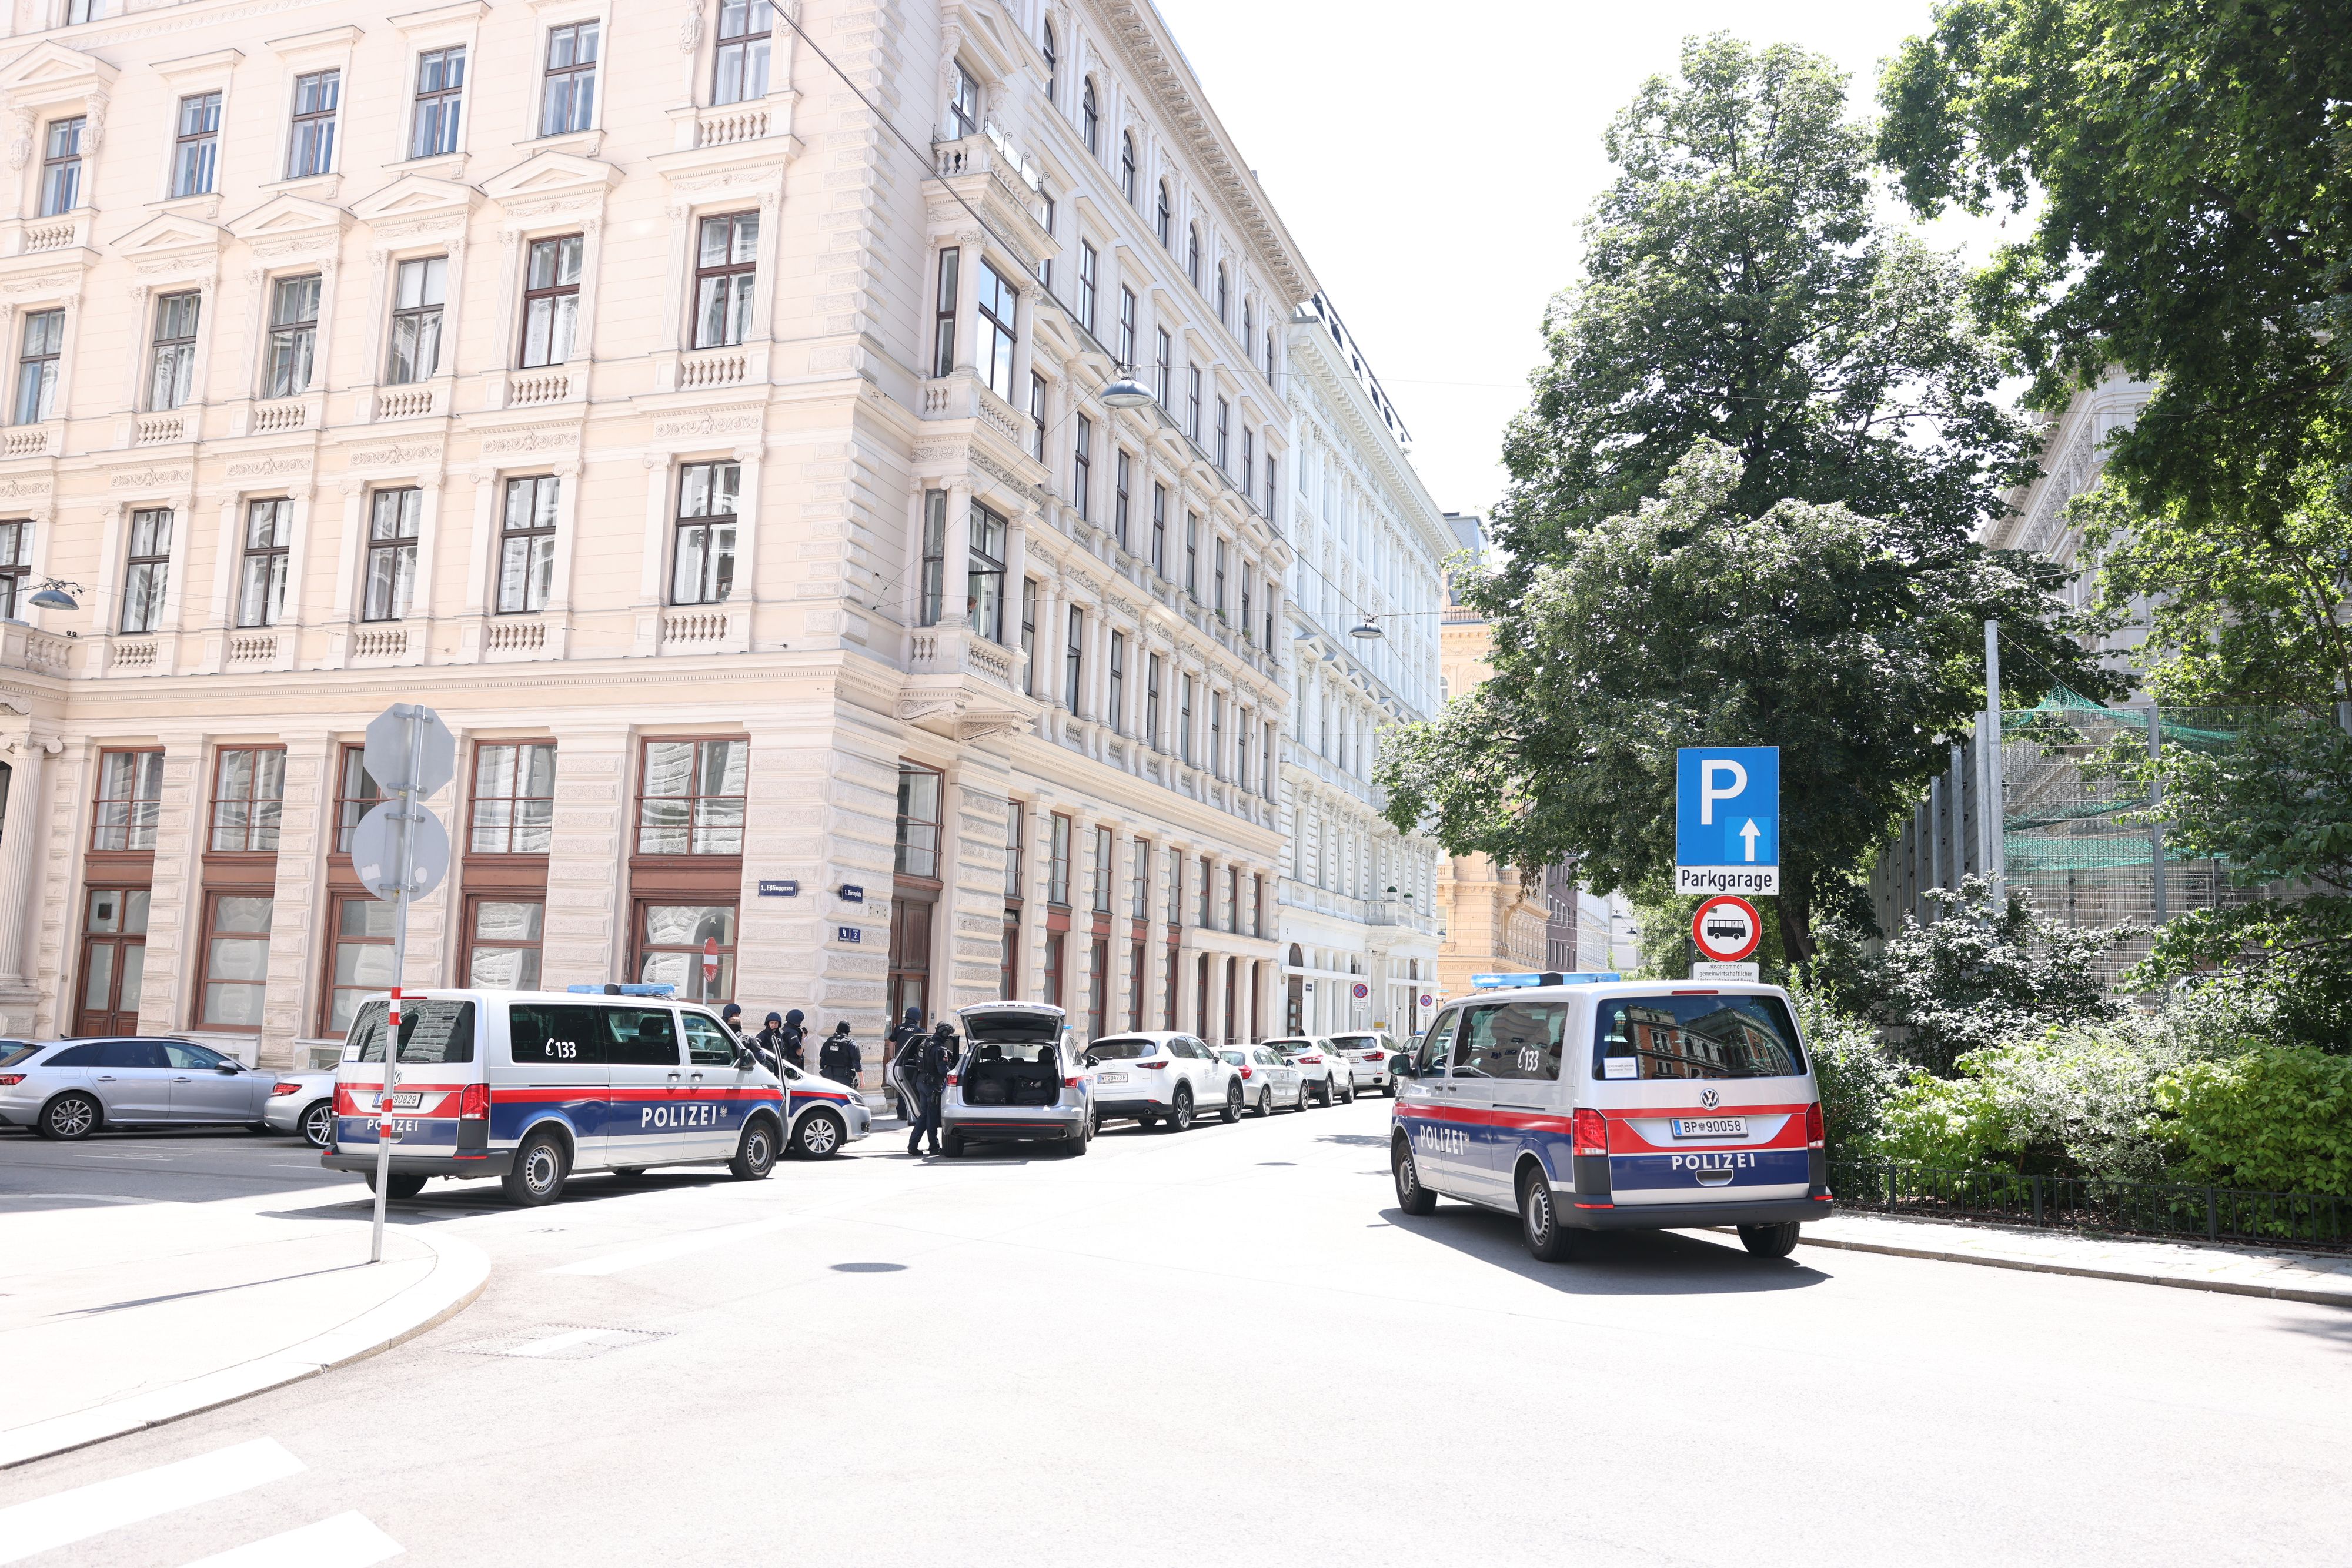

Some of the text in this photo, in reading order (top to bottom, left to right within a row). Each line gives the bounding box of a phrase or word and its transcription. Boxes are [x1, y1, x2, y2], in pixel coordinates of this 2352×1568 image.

[1701, 759, 1748, 825] P
[1682, 869, 1772, 892] Parkgarage
[843, 928, 846, 937] 4
[555, 1041, 577, 1058] 133
[1525, 1050, 1539, 1071] 133
[393, 1095, 417, 1104] 90829
[367, 1119, 419, 1131] POIZEI
[642, 1105, 717, 1128] POLIZEI
[1683, 1121, 1697, 1133] BP
[1706, 1120, 1742, 1132] 90058
[1420, 1125, 1464, 1155] POLIZEI
[1672, 1153, 1756, 1171] POLIZEI
